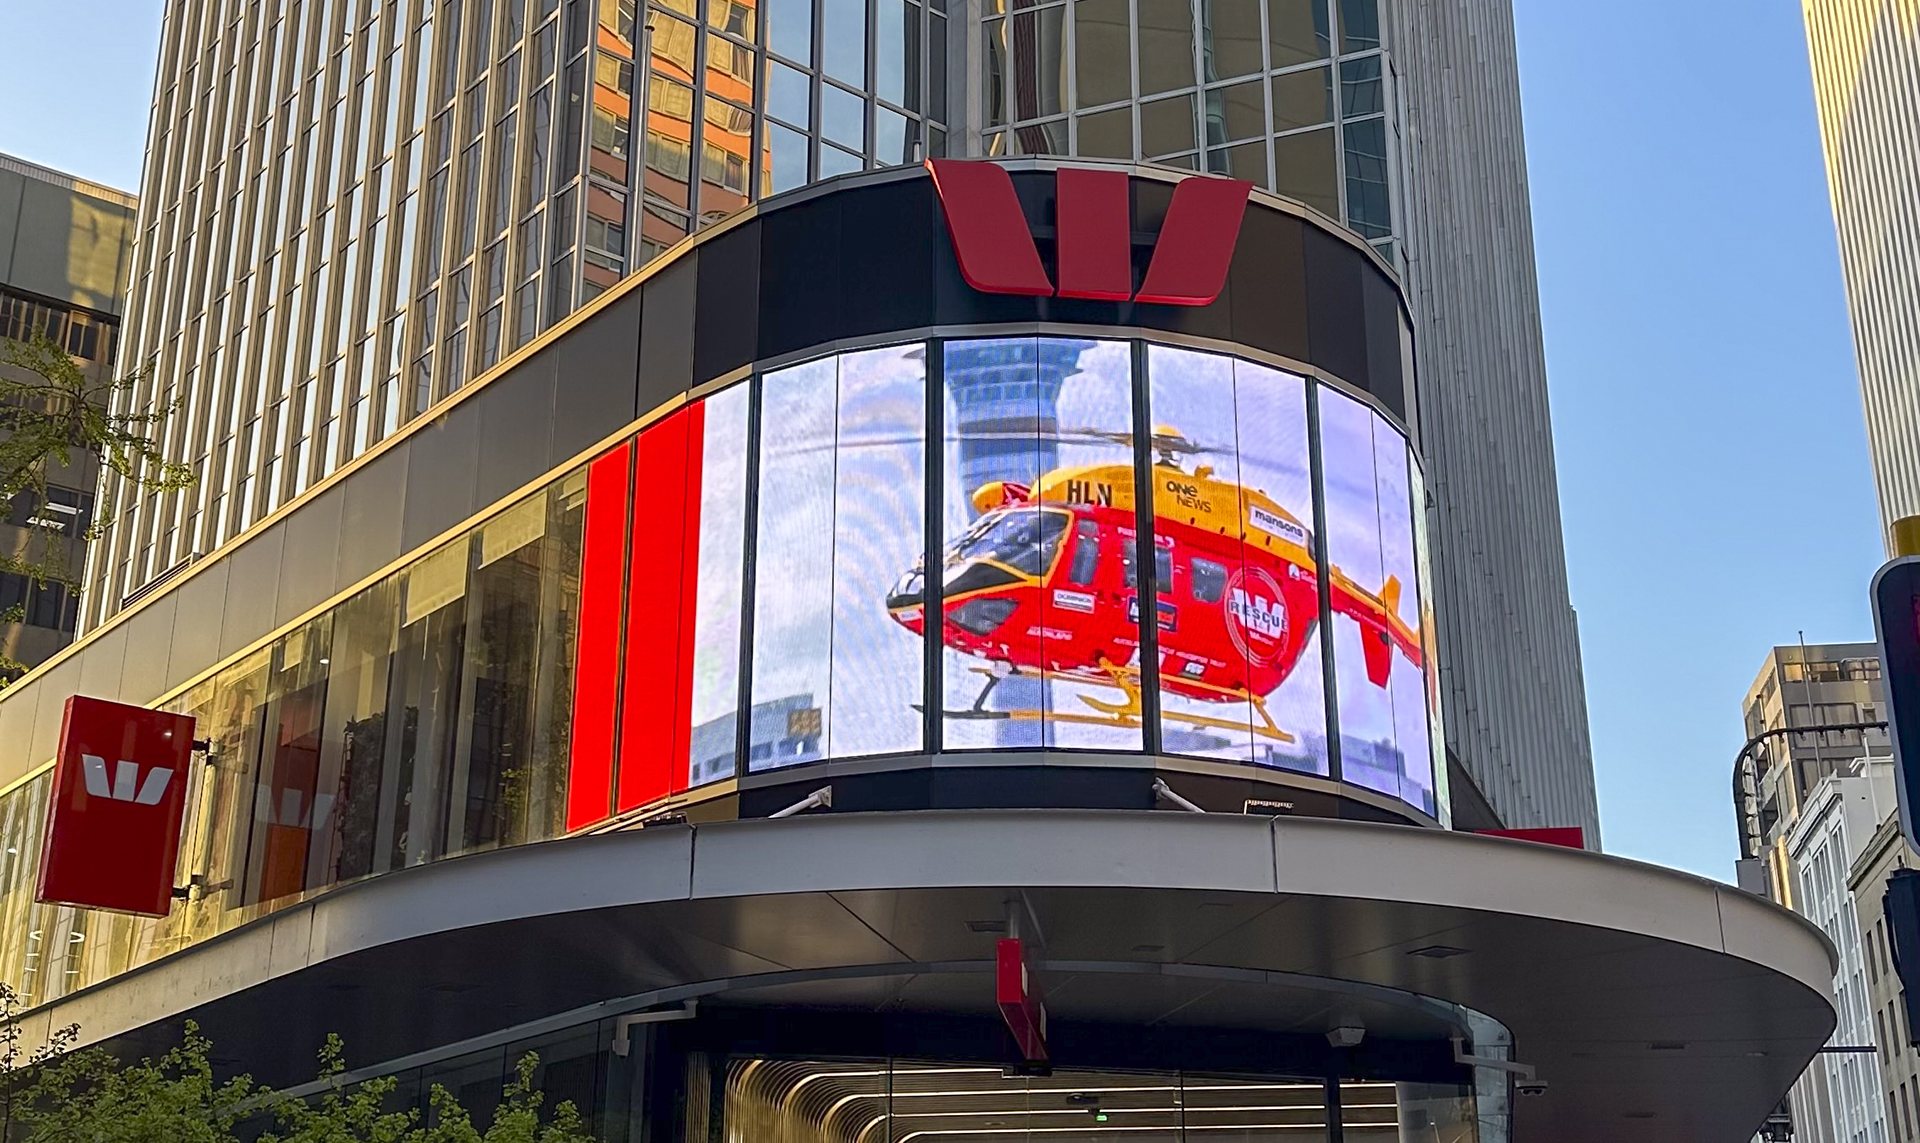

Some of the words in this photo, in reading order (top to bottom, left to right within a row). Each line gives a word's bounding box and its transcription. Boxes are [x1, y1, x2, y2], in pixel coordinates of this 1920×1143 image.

[1067, 480, 1112, 507] HLN
[1176, 494, 1212, 514] NEWS
[1255, 509, 1304, 538] mansons
[1229, 601, 1288, 631] RESCUE
